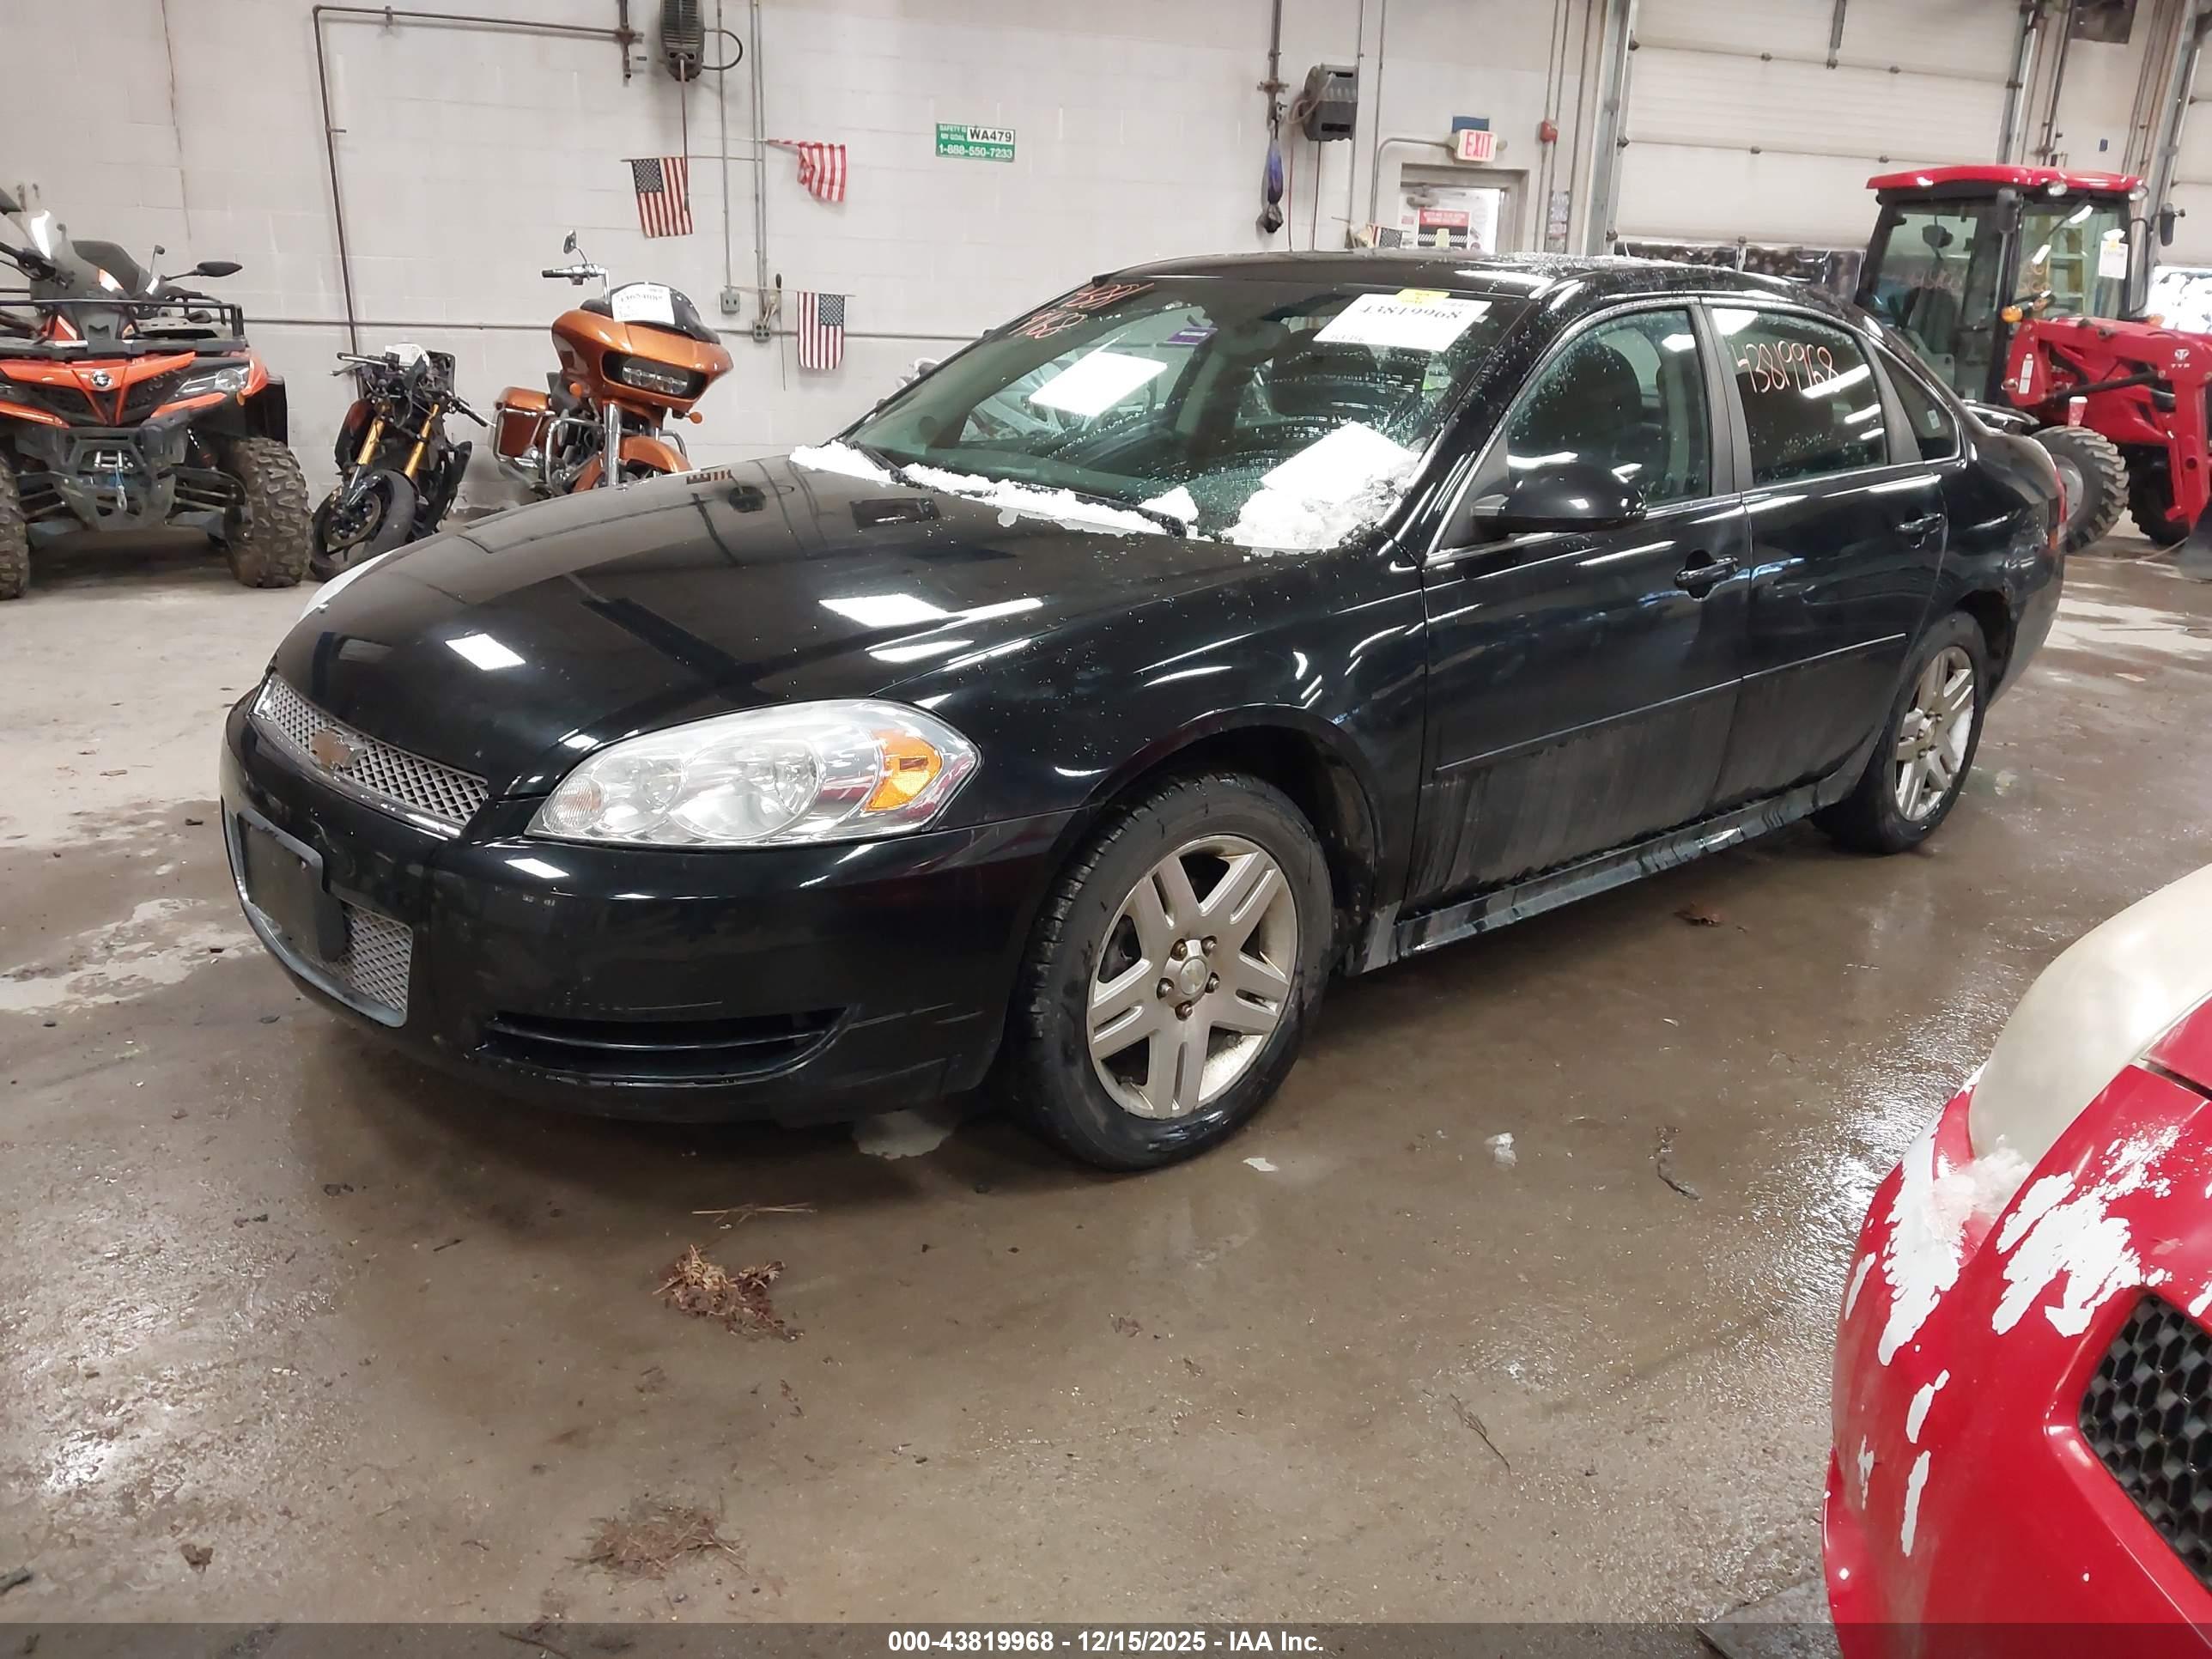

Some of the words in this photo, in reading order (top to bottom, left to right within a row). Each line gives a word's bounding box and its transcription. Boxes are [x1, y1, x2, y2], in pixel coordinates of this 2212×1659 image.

[969, 128, 1012, 143] WA479
[939, 143, 1013, 159] 1-888-550-7233
[1465, 131, 1493, 158] EXIT
